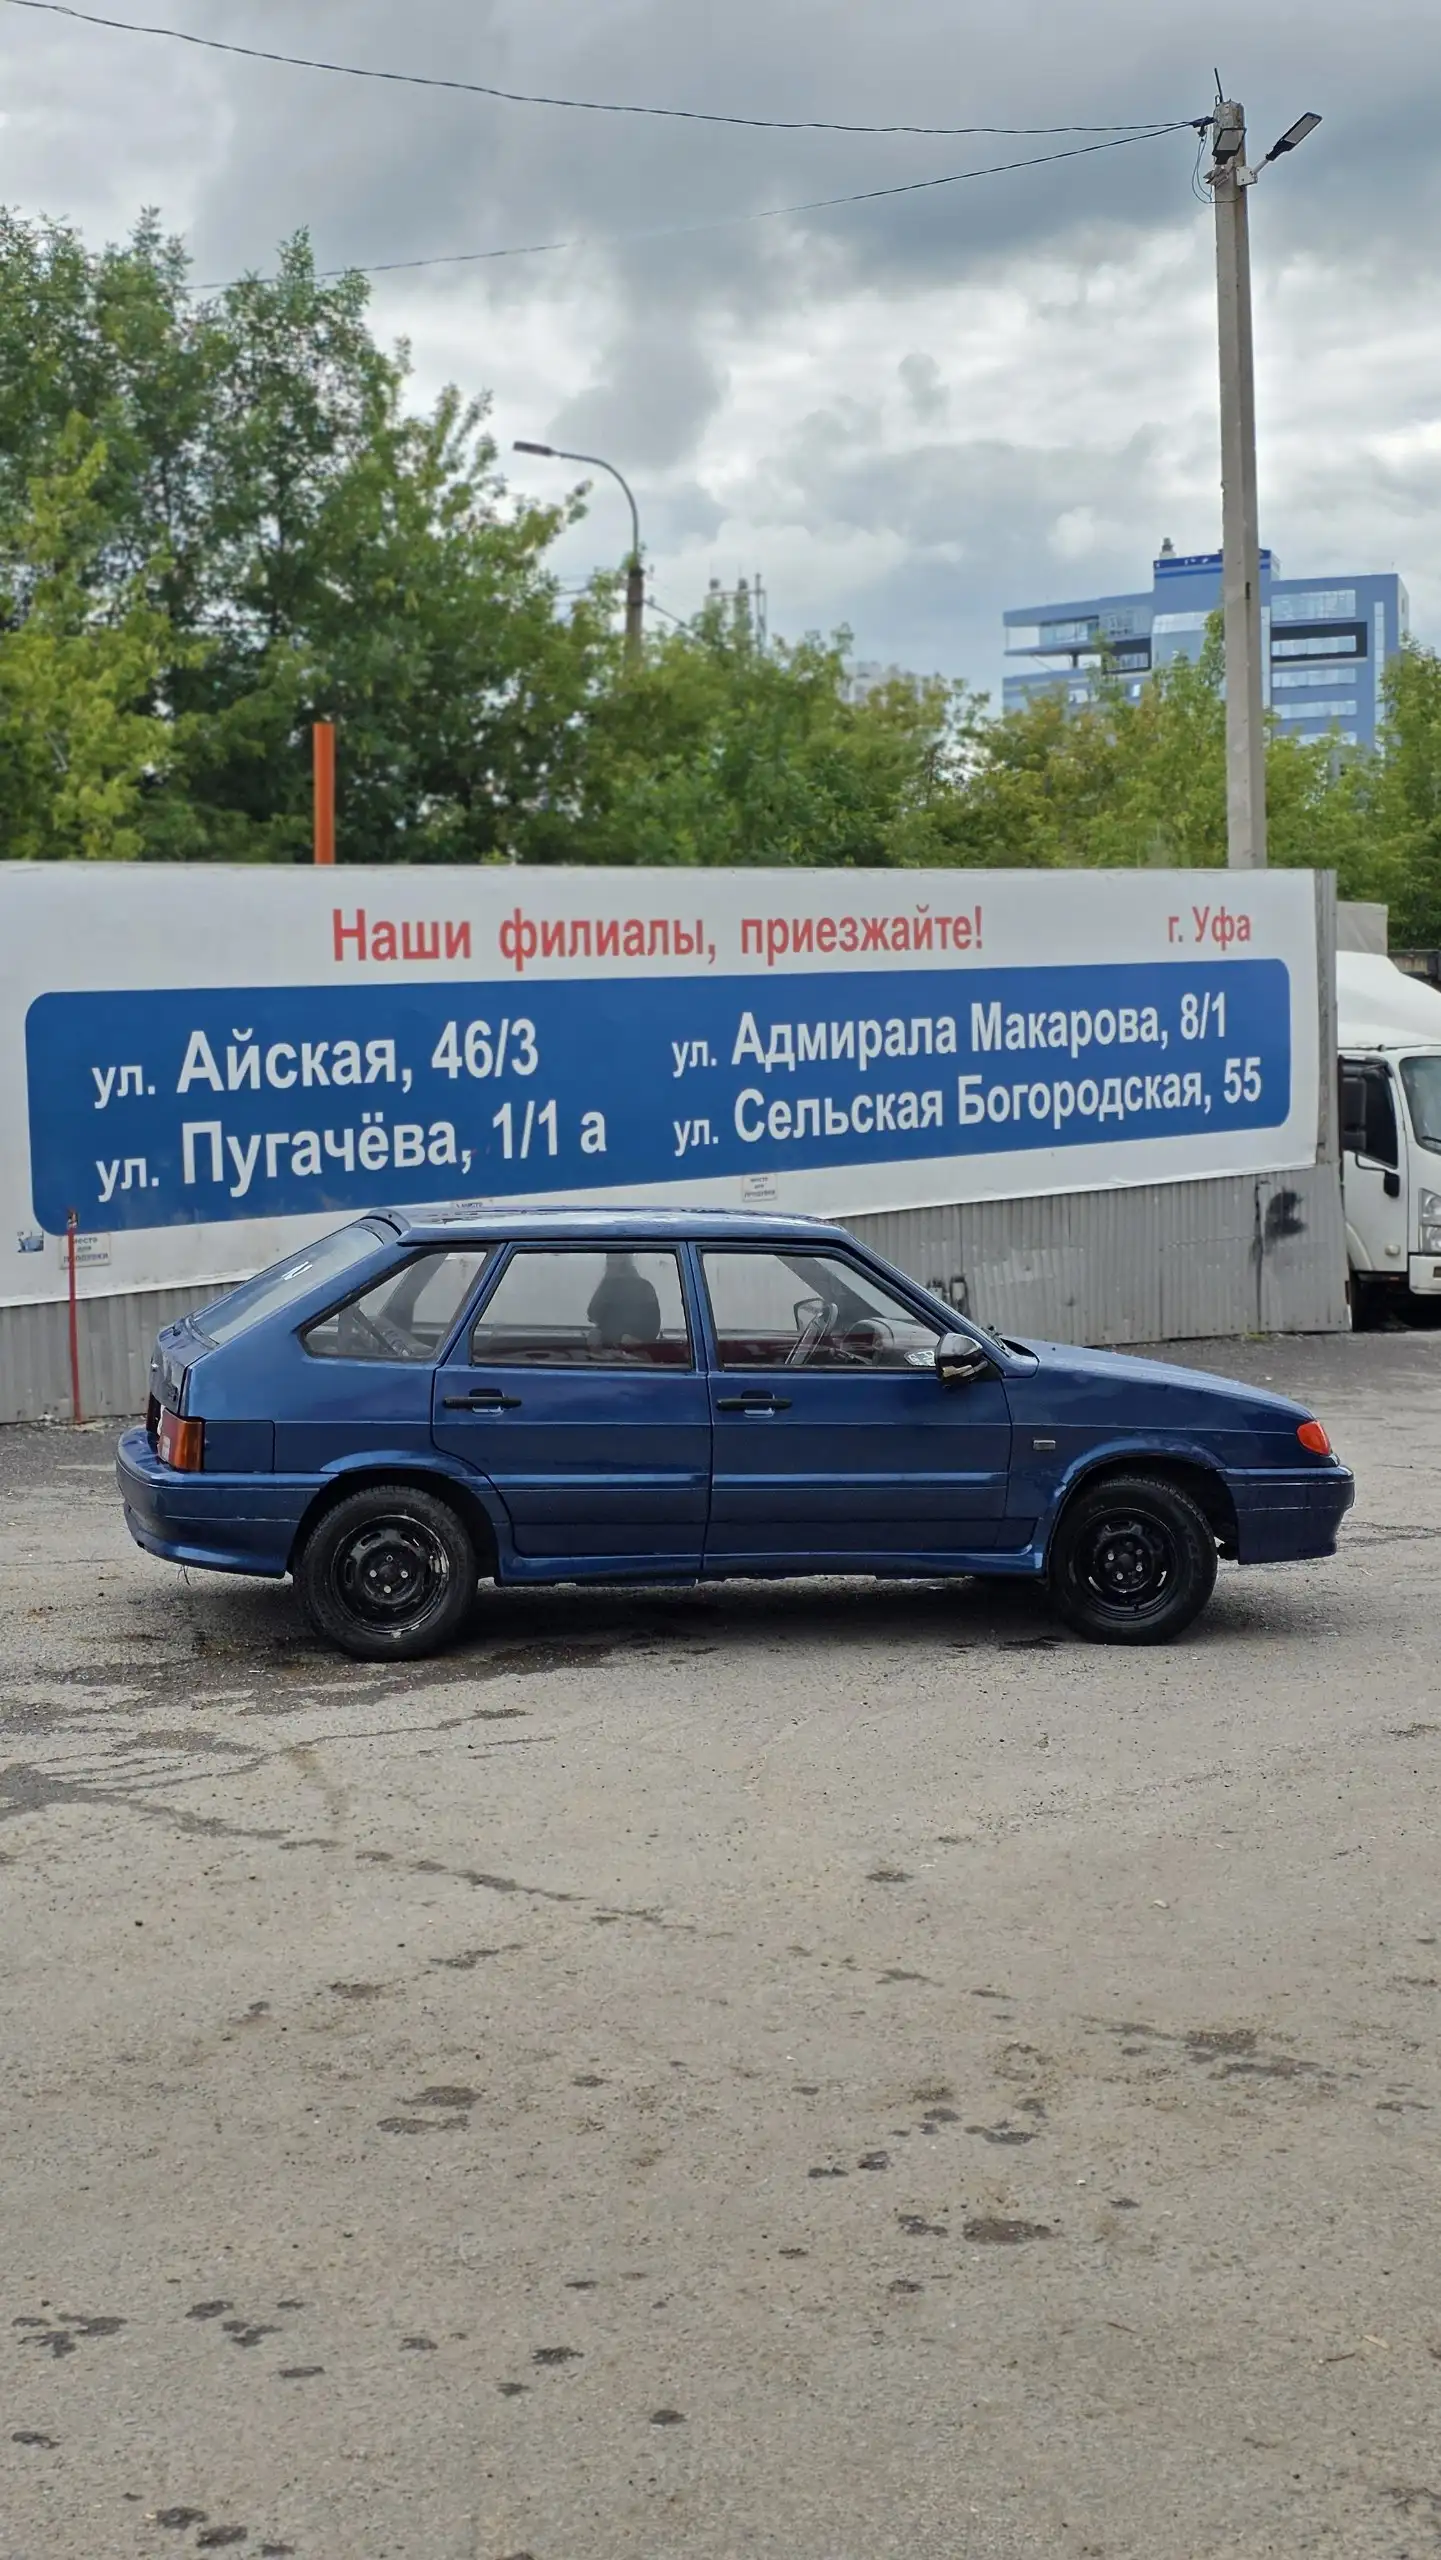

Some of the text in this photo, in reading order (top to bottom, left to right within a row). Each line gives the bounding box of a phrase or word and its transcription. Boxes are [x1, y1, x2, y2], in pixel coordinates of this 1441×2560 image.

[333, 904, 982, 972] Наши филиалы, приезжайте!
[1167, 905, 1252, 952] г. Уфа
[92, 1018, 539, 1109] ул. Айская, 46/3
[672, 991, 1226, 1078] ул. Адмирала Макарова, 8/1
[96, 1099, 607, 1202] ул. Пугачёва, 1/1 а
[673, 1056, 1262, 1157] ул. Сельская Богородская, 55
